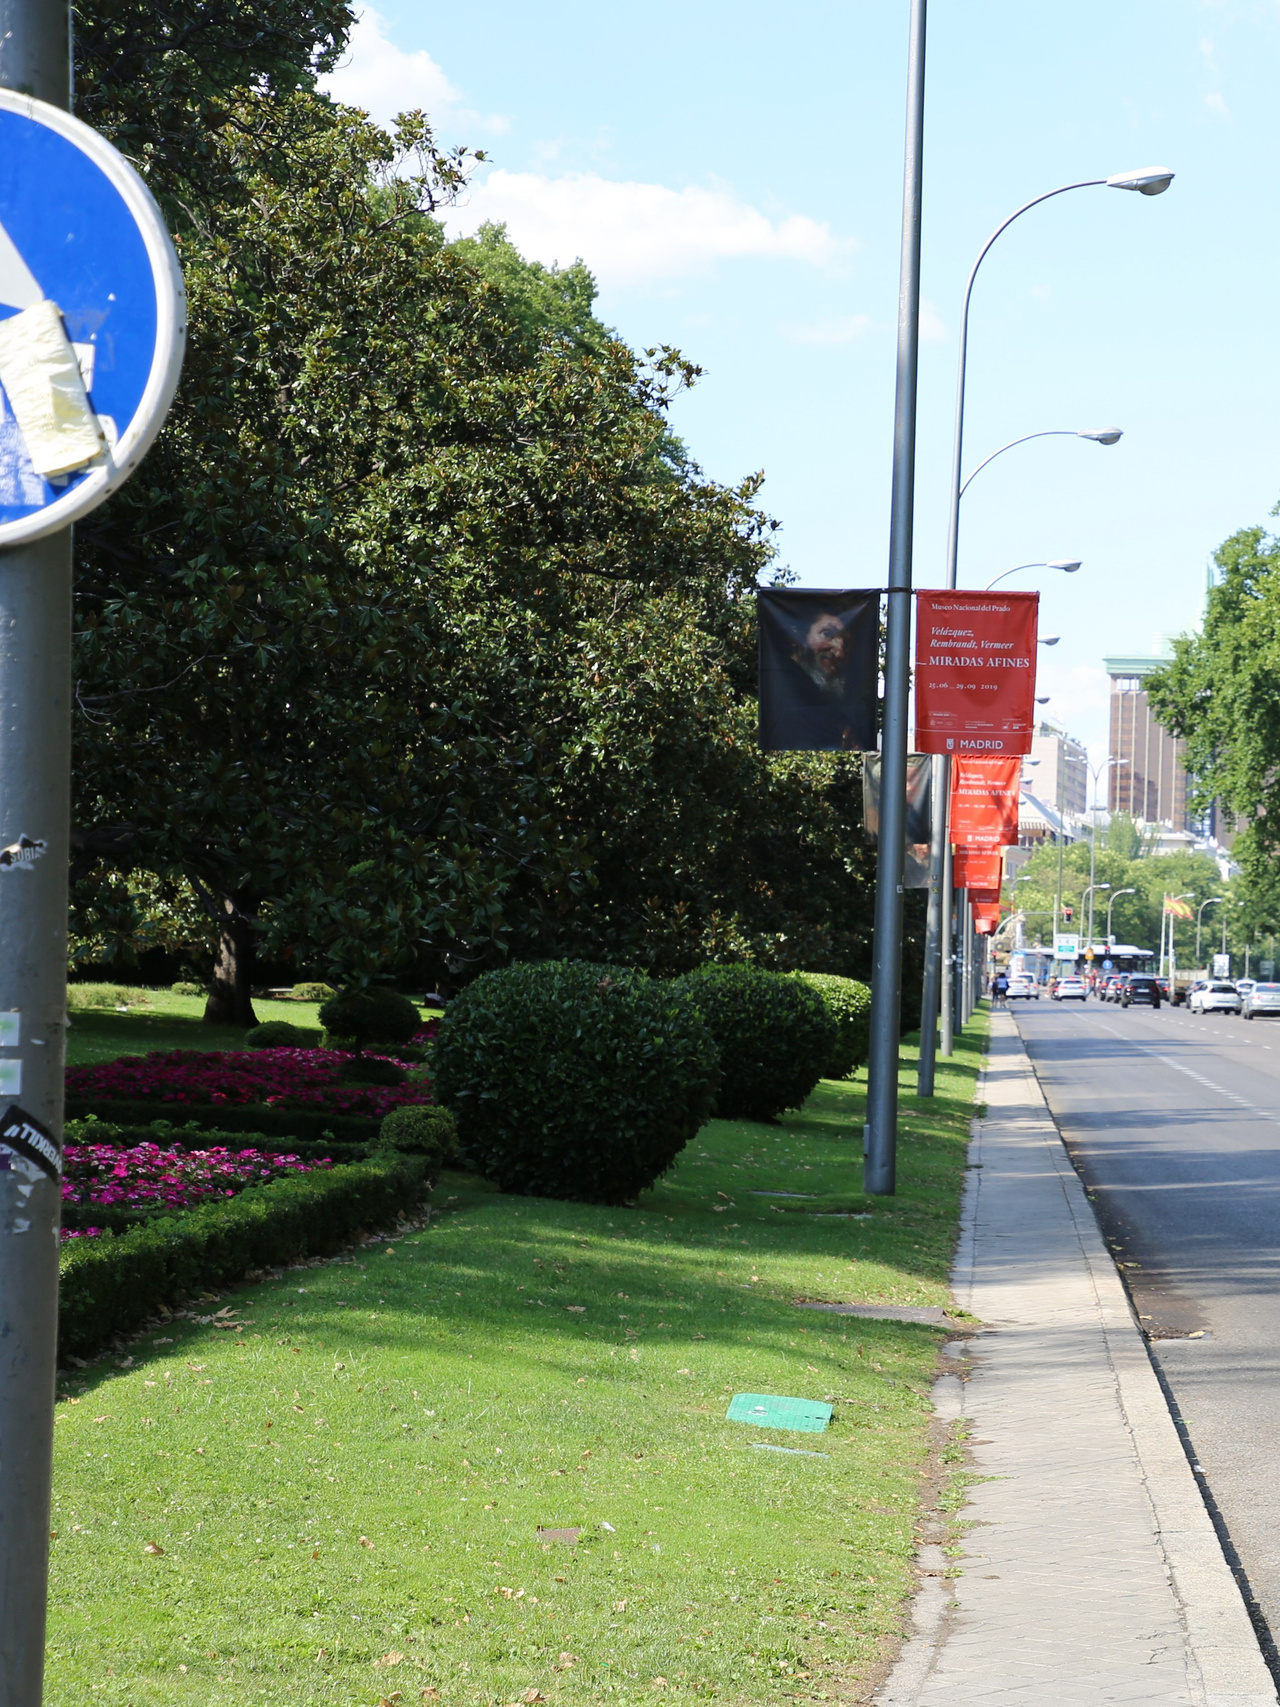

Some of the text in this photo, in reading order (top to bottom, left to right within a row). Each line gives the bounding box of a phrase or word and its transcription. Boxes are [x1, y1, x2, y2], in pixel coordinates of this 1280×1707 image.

[931, 626, 974, 638] Velázquez,
[930, 639, 1014, 649] Rembrandt, Vermeer
[929, 656, 1030, 668] MIRADAS AFINES
[960, 740, 1003, 749] MADRID
